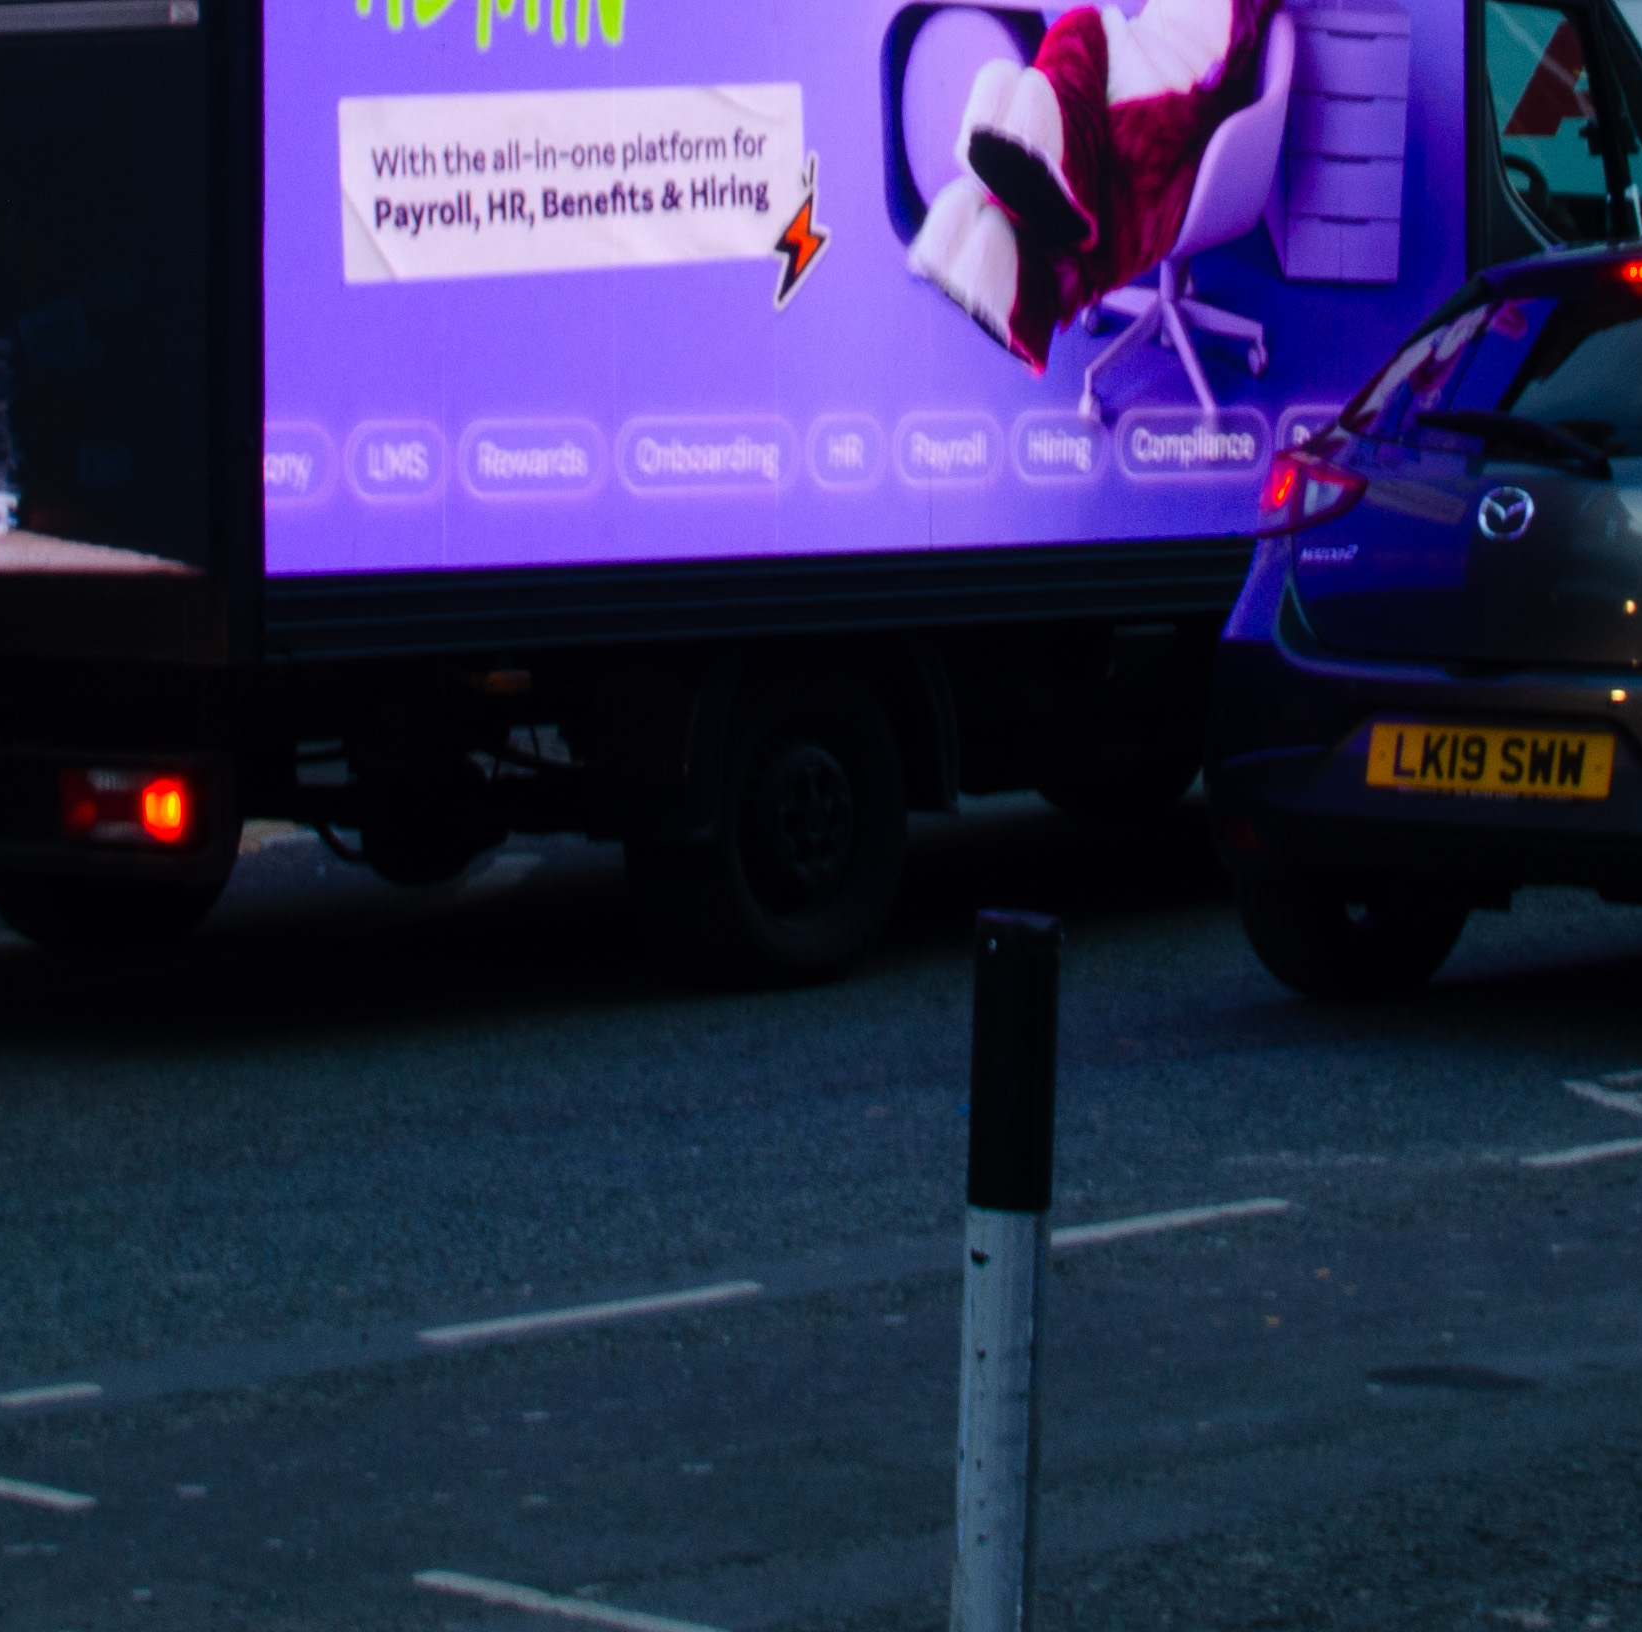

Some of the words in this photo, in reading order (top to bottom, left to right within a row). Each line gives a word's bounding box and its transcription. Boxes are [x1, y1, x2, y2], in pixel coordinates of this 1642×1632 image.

[371, 143, 437, 179] With
[444, 142, 487, 174] the
[493, 138, 616, 172] all-in-one
[622, 131, 727, 171] platform
[733, 127, 767, 159] for
[375, 191, 481, 237] Payroll,
[488, 189, 535, 228] HR,
[542, 181, 654, 220] Benefits
[661, 179, 683, 210] &
[690, 173, 769, 216] Hiring
[367, 441, 429, 482] LMS
[477, 439, 589, 478] Rewards
[635, 436, 781, 483] Onboarding
[827, 434, 865, 468] HR
[911, 431, 988, 472] Payroll
[1027, 429, 1092, 473] Hiring
[1132, 428, 1255, 468] Compliance
[1393, 732, 1487, 780] LK19
[1499, 739, 1586, 786] SWW
